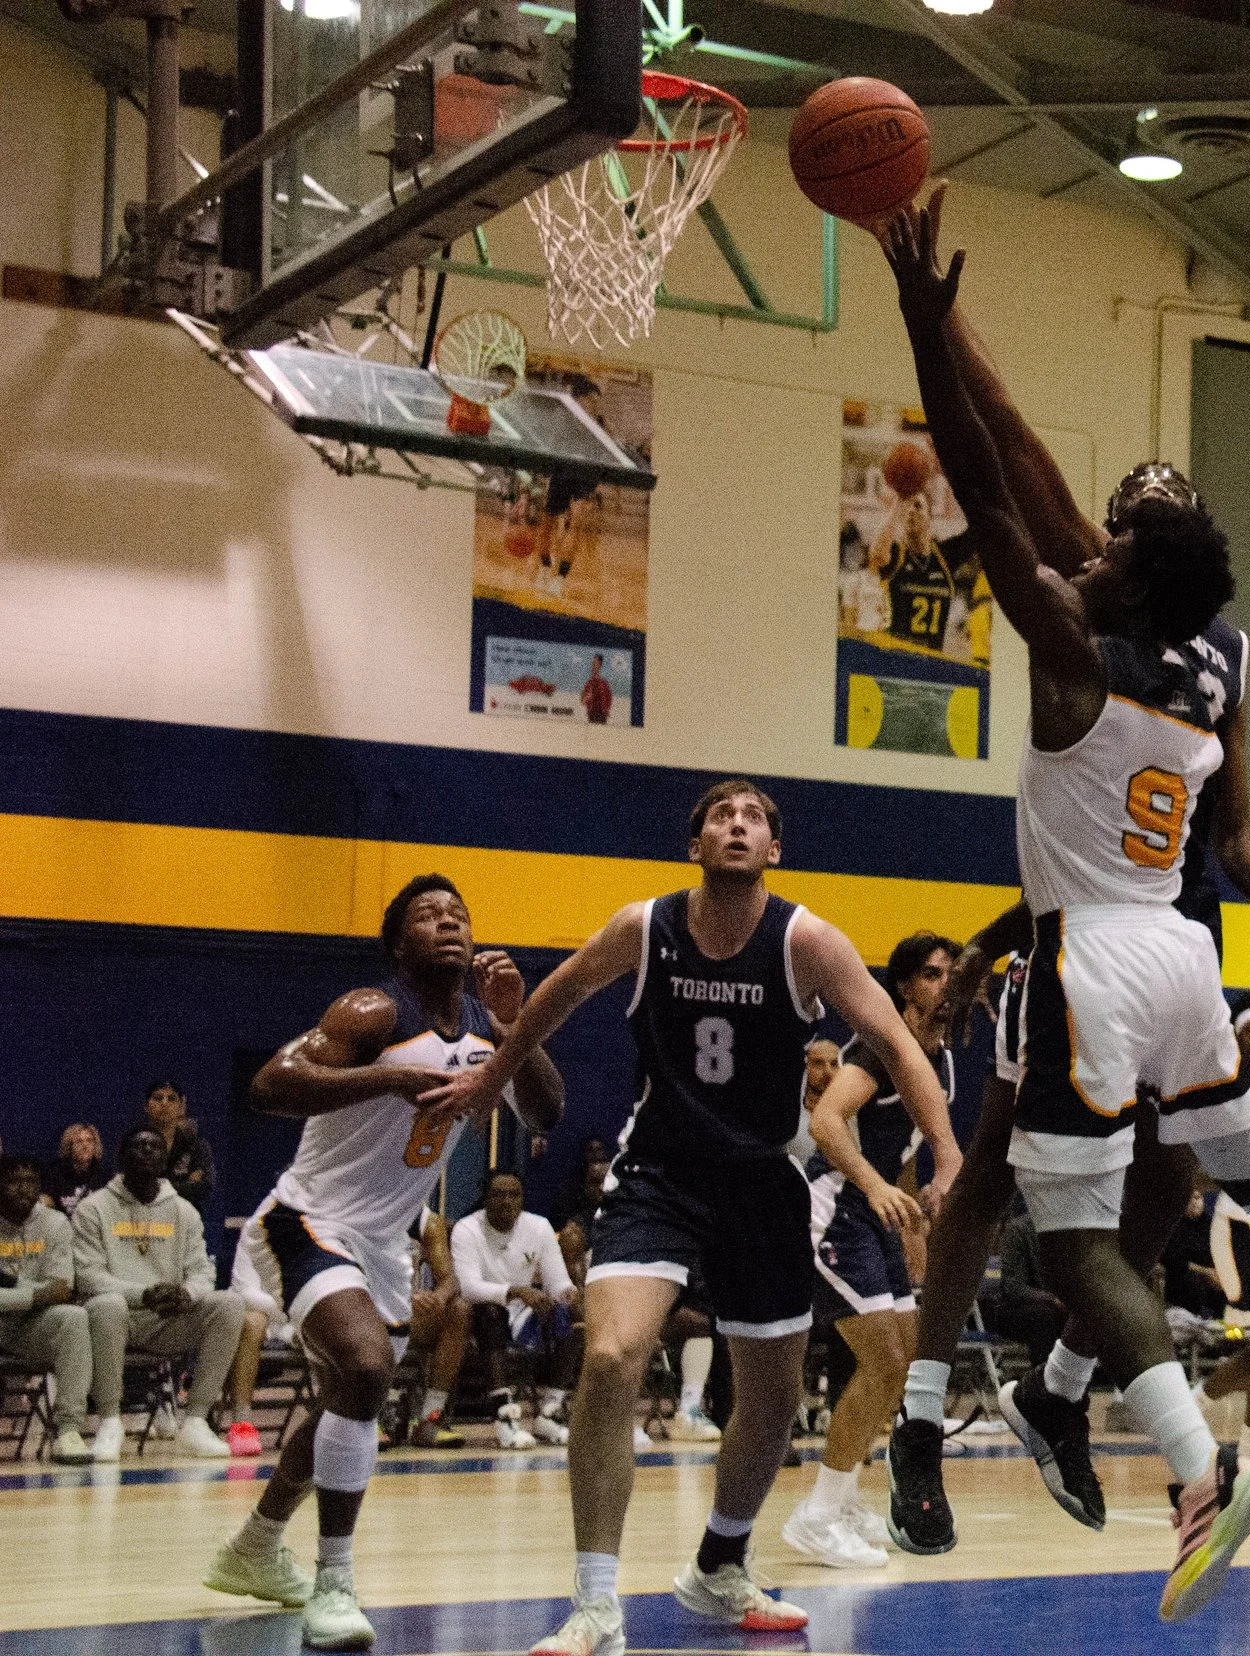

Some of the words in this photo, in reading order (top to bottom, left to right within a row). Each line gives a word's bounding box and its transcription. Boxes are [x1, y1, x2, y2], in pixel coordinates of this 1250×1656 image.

[911, 595, 942, 635] 21
[1121, 765, 1188, 871] 9
[670, 975, 764, 1005] TORONTO
[695, 1016, 735, 1085] 8
